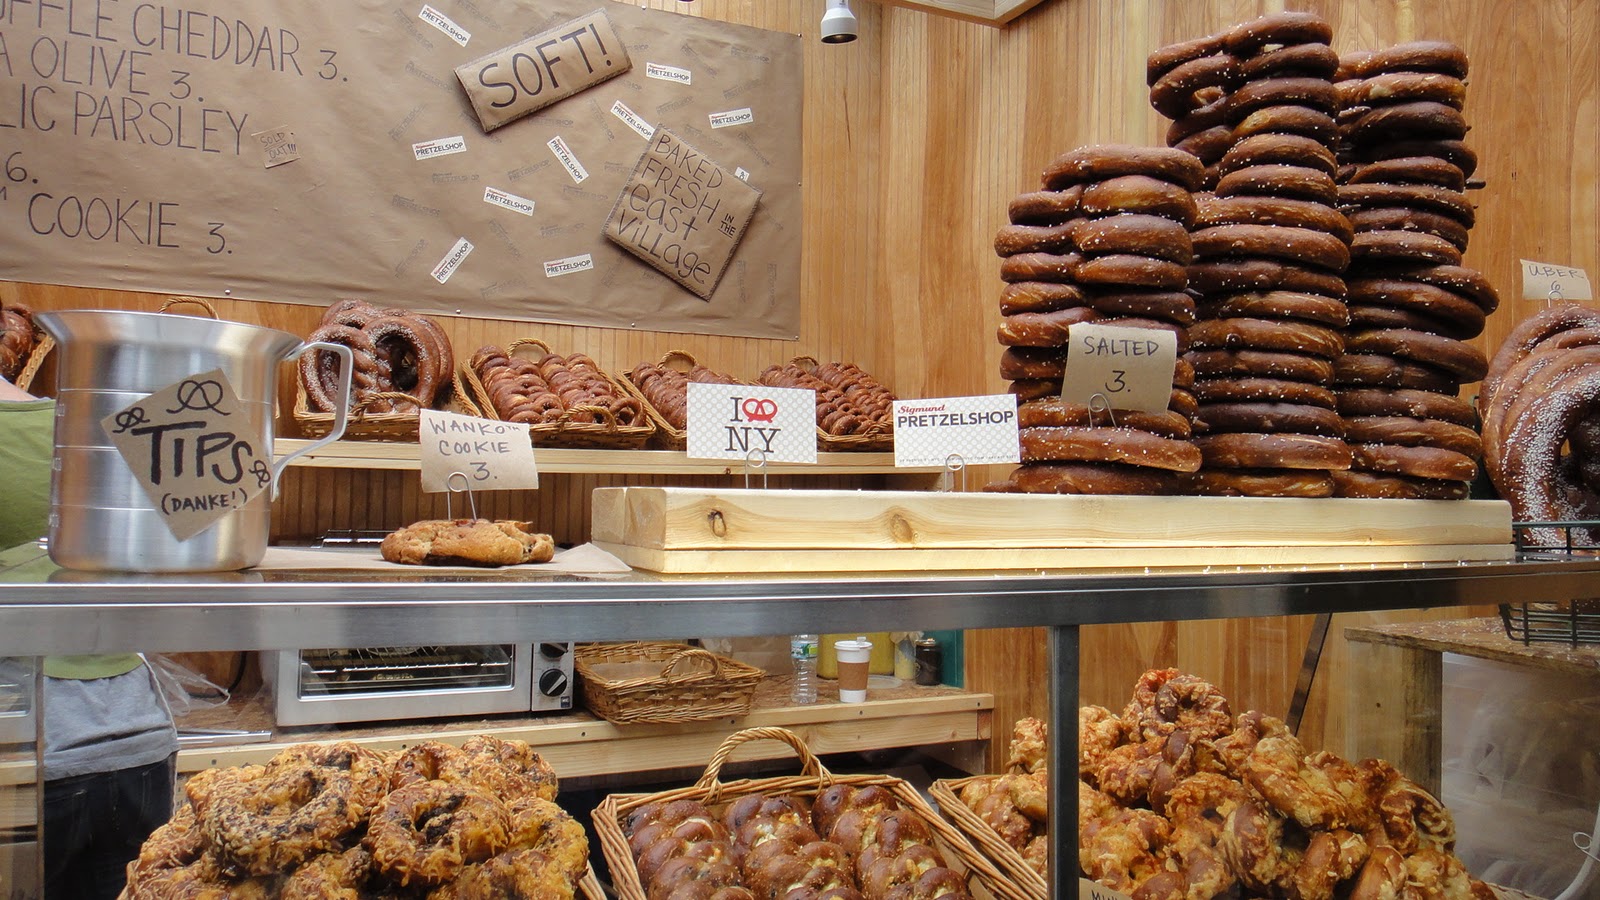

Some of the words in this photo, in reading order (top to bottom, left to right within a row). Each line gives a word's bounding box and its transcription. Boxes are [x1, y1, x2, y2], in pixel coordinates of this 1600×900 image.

[422, 10, 467, 42] PRETZELSHOP
[0, 0, 118, 42] FFLE
[133, 4, 303, 76] CHEDDAR
[319, 50, 348, 82] 3.
[31, 36, 152, 96] OLIVE
[170, 71, 204, 102] 3.
[479, 23, 612, 107] SOFT!
[648, 68, 689, 80] PRETZELSHOP
[74, 91, 248, 155] PARSLEY
[614, 106, 652, 137] PRETZELSHOP
[712, 114, 750, 125] PRETZELSHOP
[260, 133, 285, 148] SOLD
[415, 141, 463, 156] PRETZELSHOP
[6, 151, 38, 184] 6.
[551, 140, 584, 180] PRETZELSHOP
[655, 134, 723, 188] BAKED
[486, 193, 532, 212] PRETZELSHOP
[642, 157, 720, 223] FRESH
[28, 193, 180, 248] COOKIE
[207, 222, 232, 254] 3.
[630, 183, 698, 240] east
[724, 213, 734, 223] IN
[721, 220, 736, 235] THE
[437, 242, 469, 280] PRETZELSHOP
[546, 260, 591, 273] PRETZELSHOP
[1528, 265, 1584, 278] UBER
[1084, 336, 1159, 356] SALTED
[1105, 370, 1131, 392] 3.
[730, 397, 743, 422] I
[898, 404, 946, 415] Sigmund
[898, 411, 1014, 428] PRETZELSHOP
[439, 440, 511, 456] COOKIE
[725, 426, 781, 453] NY
[131, 421, 252, 485] TIPS
[470, 462, 497, 480] 3.
[161, 488, 247, 515] (DANKE!)
